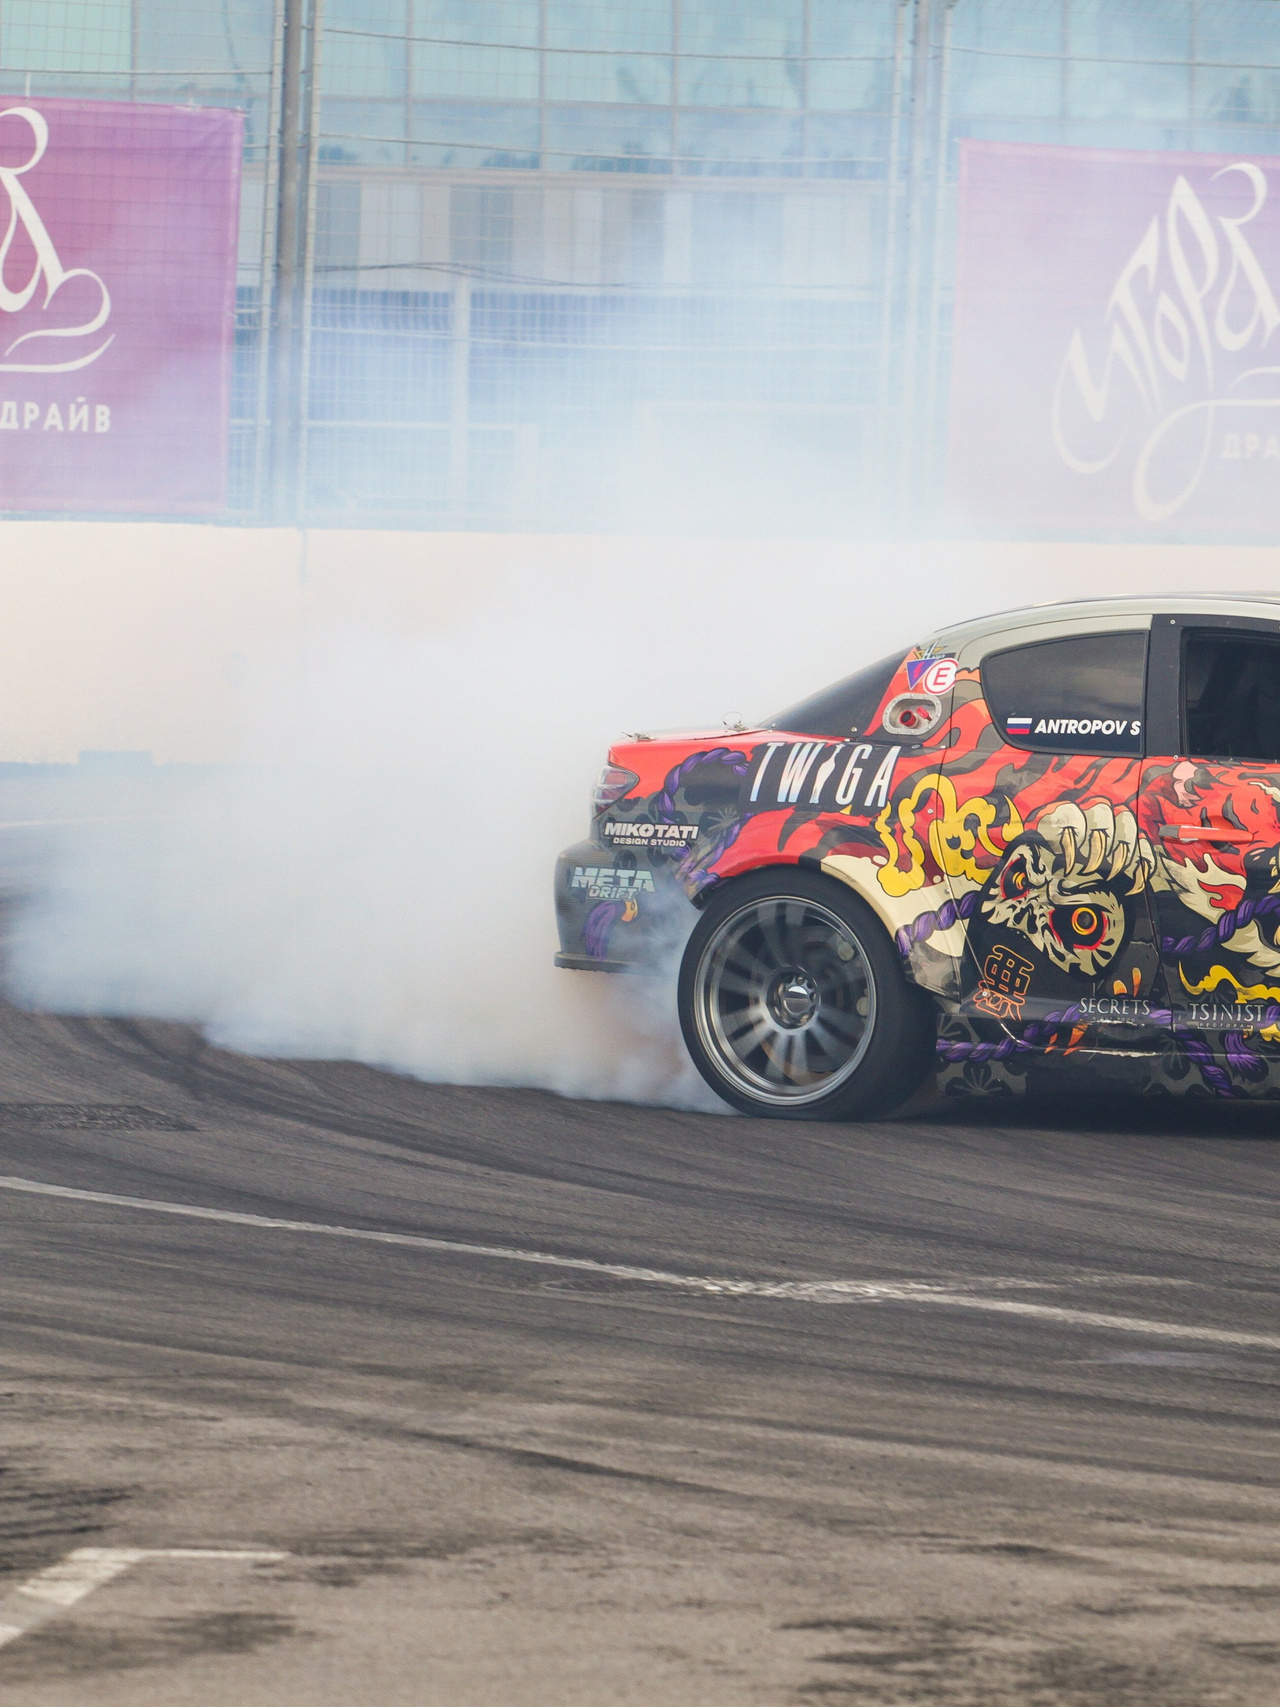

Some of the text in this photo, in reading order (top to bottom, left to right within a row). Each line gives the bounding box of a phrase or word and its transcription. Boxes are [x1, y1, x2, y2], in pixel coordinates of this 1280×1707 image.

[0, 397, 111, 433] ДРАЙВ
[932, 667, 951, 686] E
[1034, 719, 1142, 736] ANTROPOV S
[750, 742, 902, 808] TWIGA
[604, 822, 699, 840] MIKOTATI
[612, 837, 687, 848] DESIGN STUDIO
[571, 866, 656, 892] META
[1079, 997, 1150, 1015] SECRETS
[1189, 1003, 1264, 1022] TSINIST
